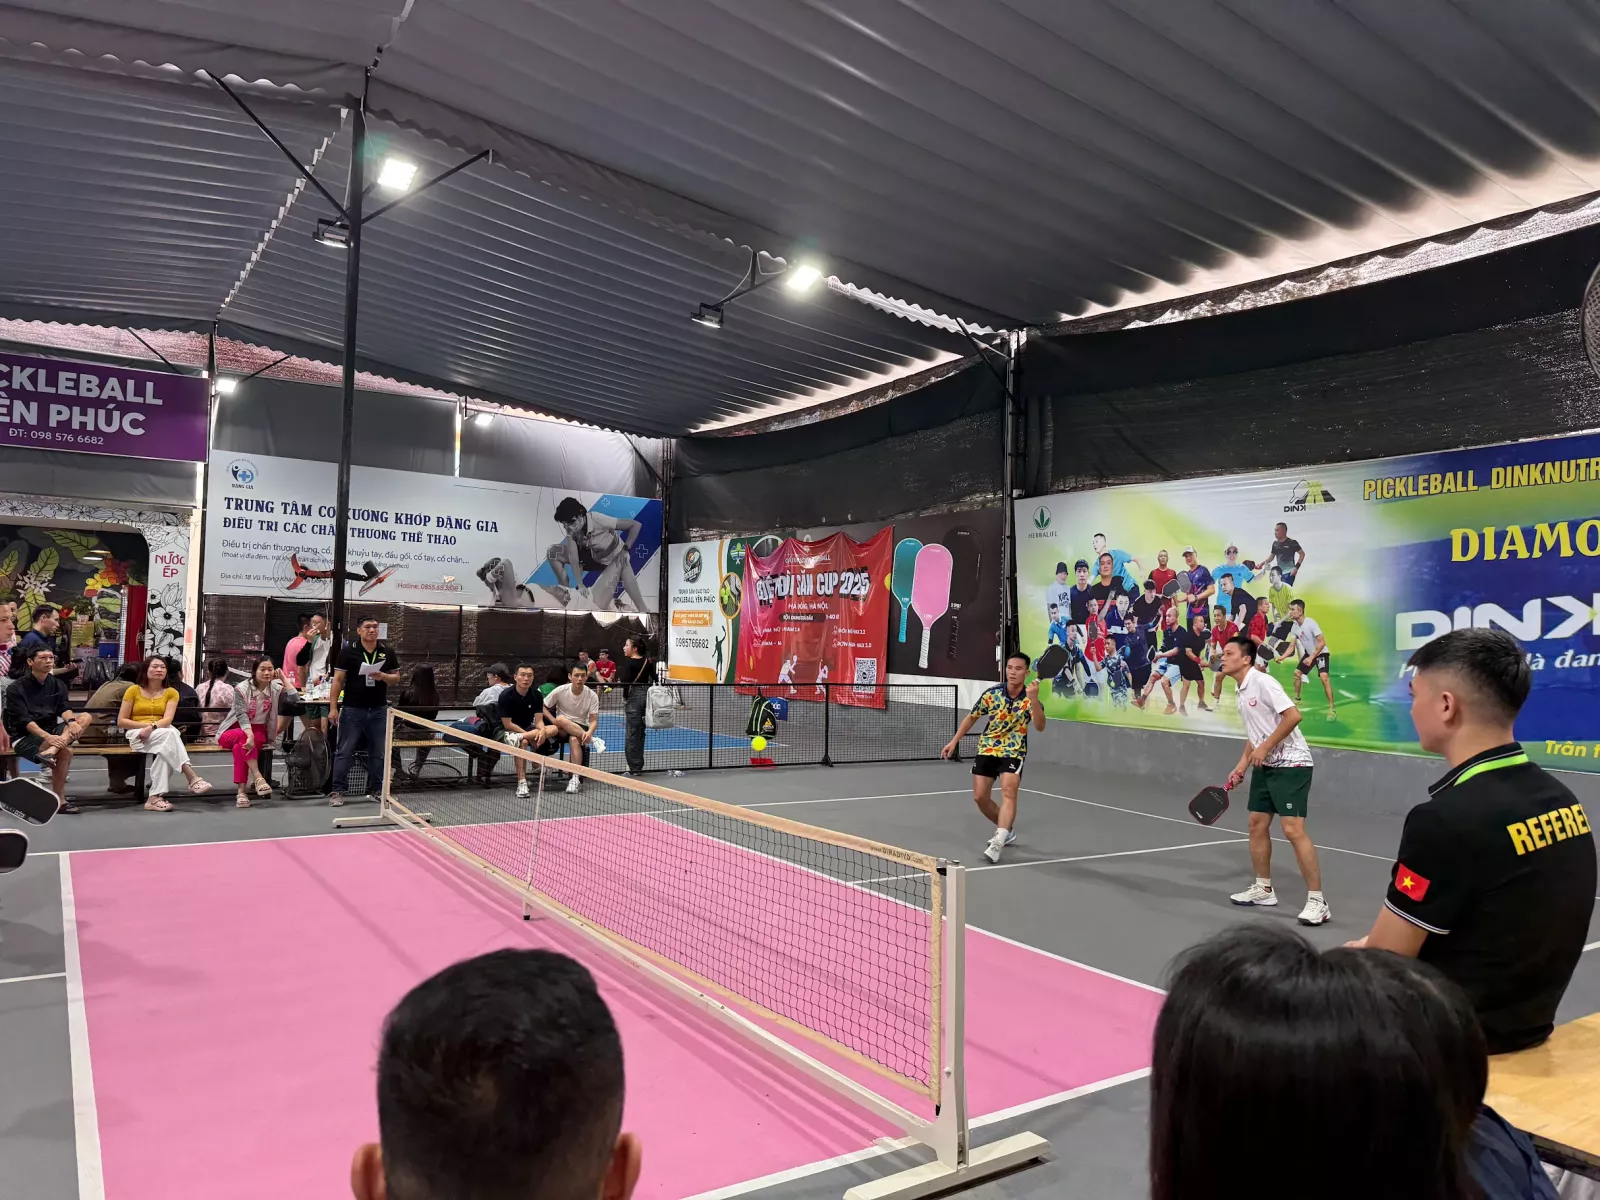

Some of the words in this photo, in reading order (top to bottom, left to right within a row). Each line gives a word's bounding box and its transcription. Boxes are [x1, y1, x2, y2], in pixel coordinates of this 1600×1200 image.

[48, 403, 146, 436] PHÚC
[8, 428, 27, 438] ĐT:
[30, 430, 52, 440] 098
[55, 432, 74, 442] 576
[77, 434, 104, 445] 6682
[1363, 470, 1479, 501] PICKLEBALL
[224, 496, 275, 513] TRUNG
[280, 500, 313, 517] TÂM
[318, 505, 337, 519] CƠ
[394, 511, 431, 528] KHỚP
[436, 515, 472, 531] ĐẶNG
[476, 520, 499, 533] GIA
[283, 521, 307, 534] CÁC
[426, 534, 457, 545] THAO
[1028, 531, 1058, 539] HERBALIFE
[1450, 520, 1600, 562] DIAMO
[371, 551, 384, 559] tay,
[424, 555, 436, 563] tay,
[816, 572, 838, 596] CUP
[1545, 740, 1587, 756] Trân
[1507, 804, 1592, 856] REFERE
